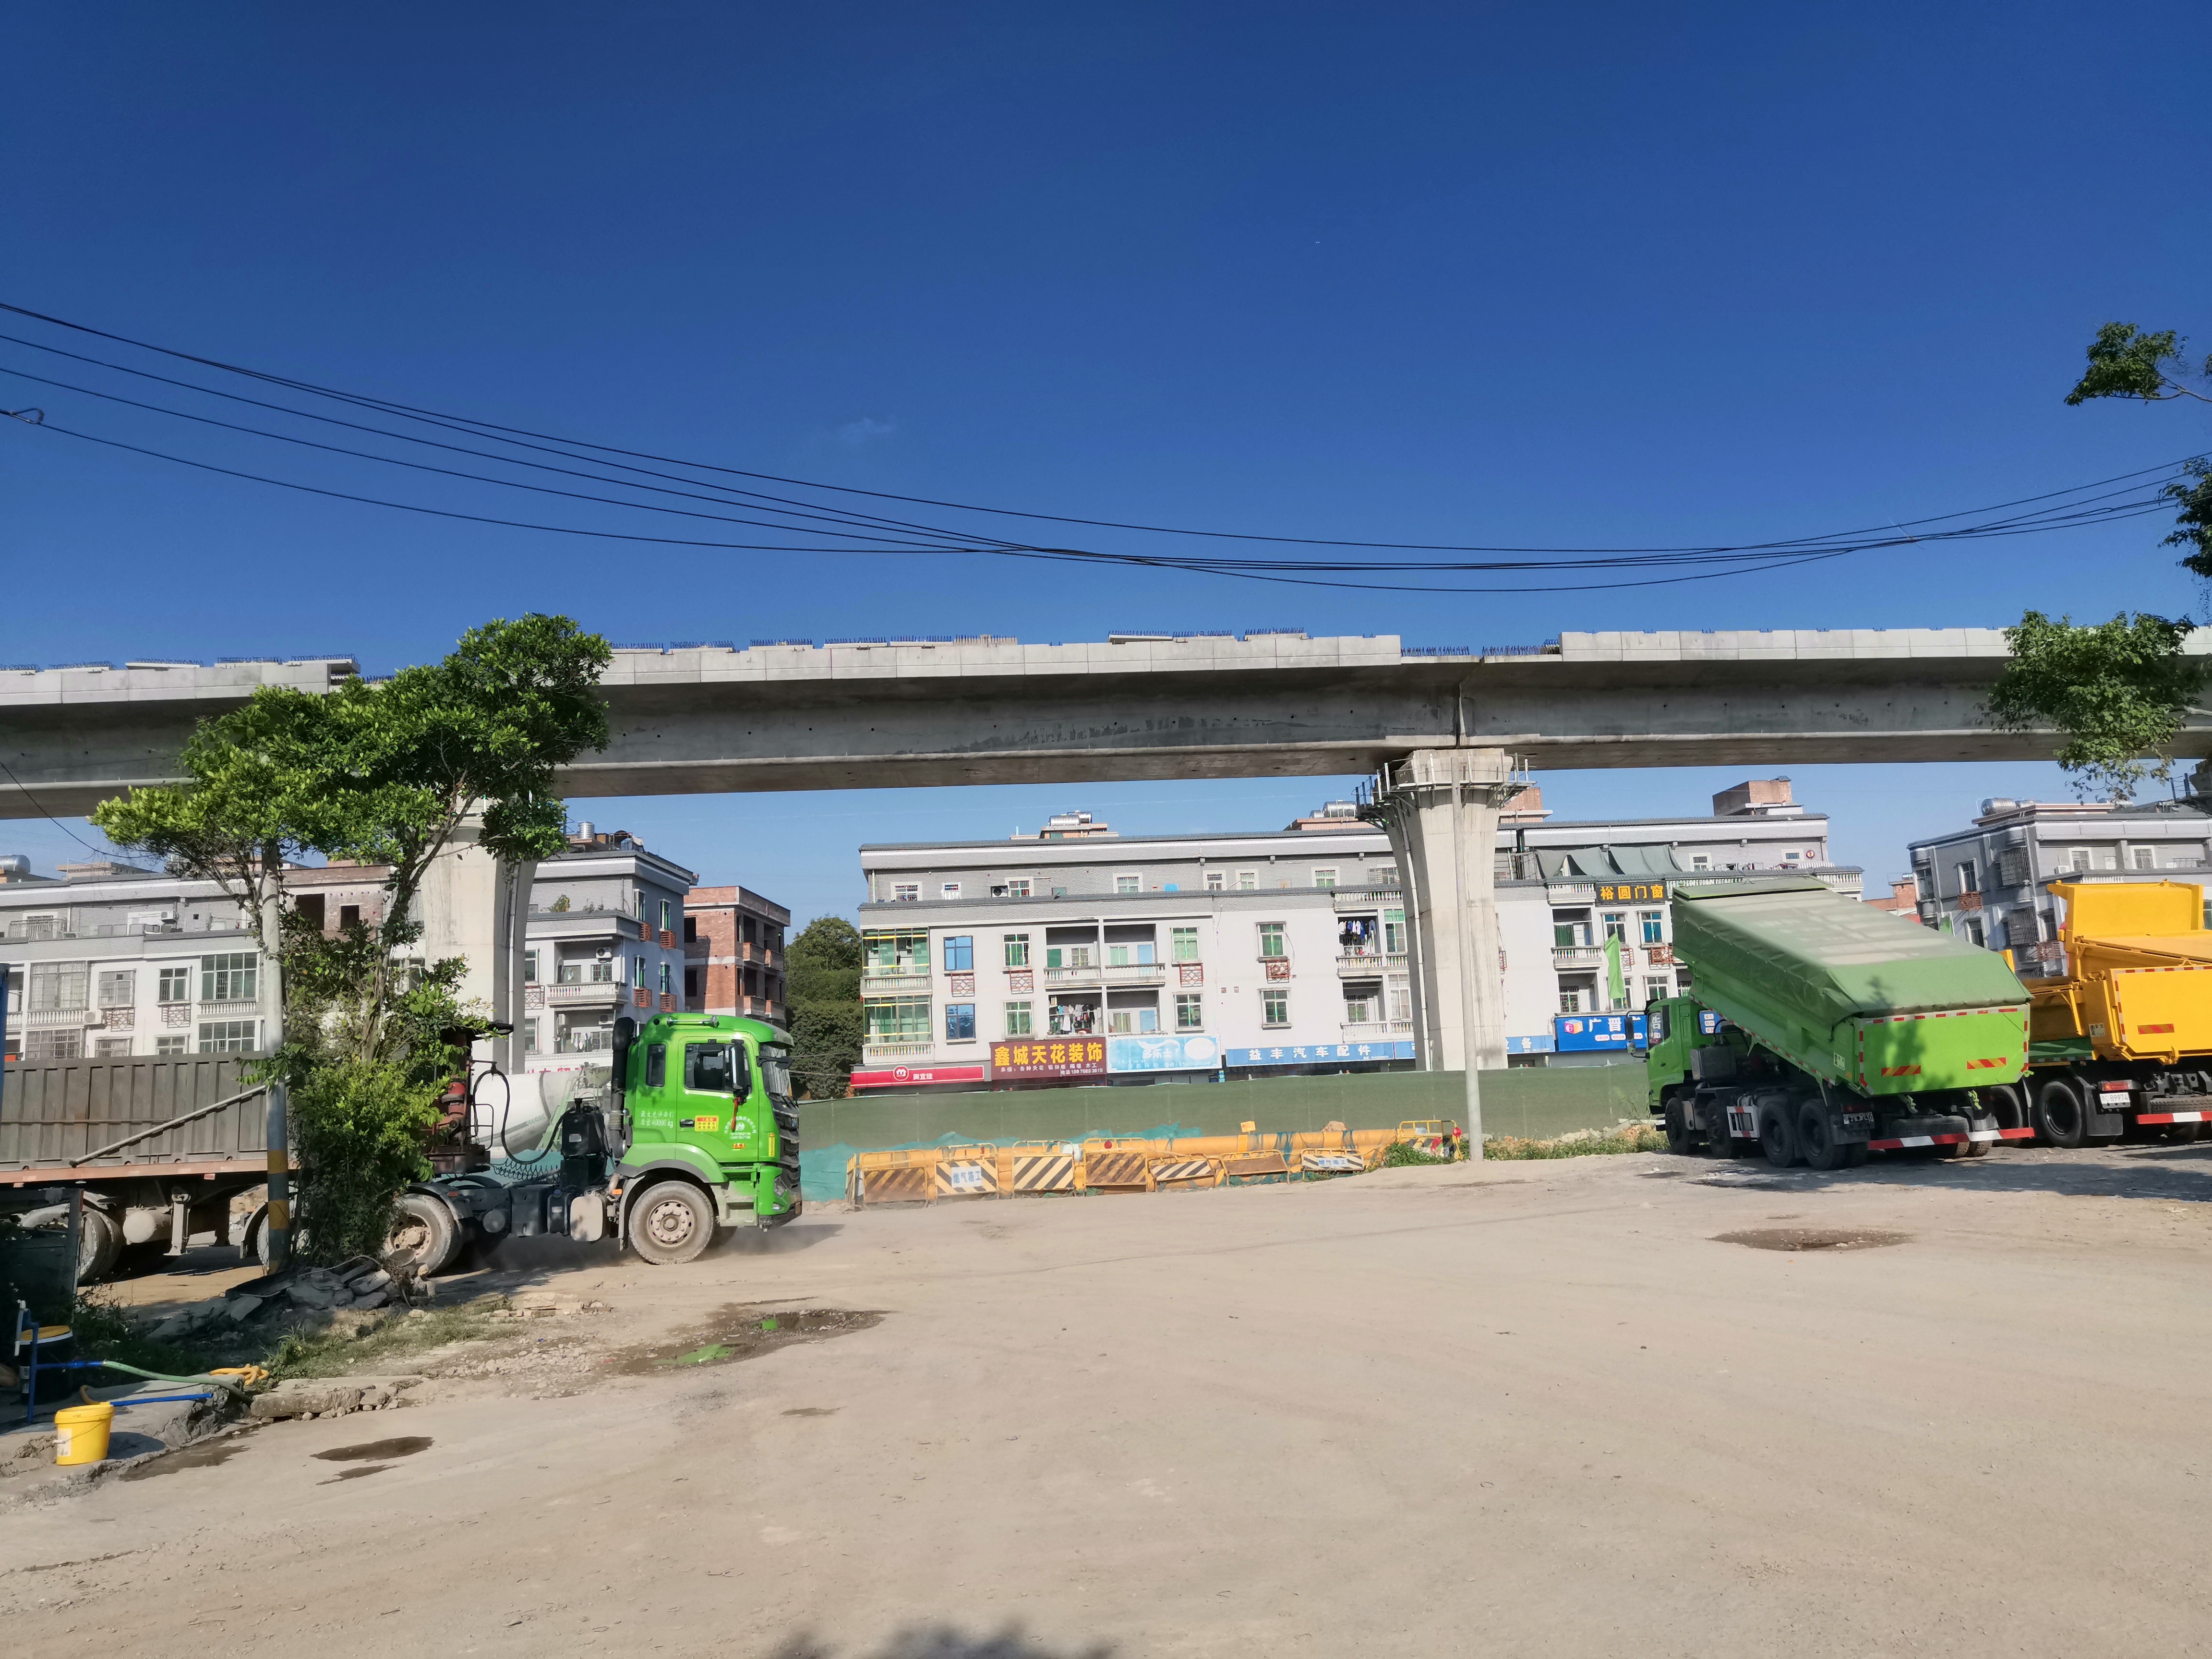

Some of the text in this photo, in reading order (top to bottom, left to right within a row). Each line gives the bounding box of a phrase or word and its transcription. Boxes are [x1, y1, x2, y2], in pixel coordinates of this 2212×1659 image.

[1600, 884, 1663, 900] 裕圆门窗
[995, 1042, 1102, 1066] 鑫城天花装饰
[1142, 1048, 1173, 1059] 多乐士
[1249, 1045, 1371, 1061] 益丰汽车配件
[953, 1170, 982, 1184] 燃气施工
